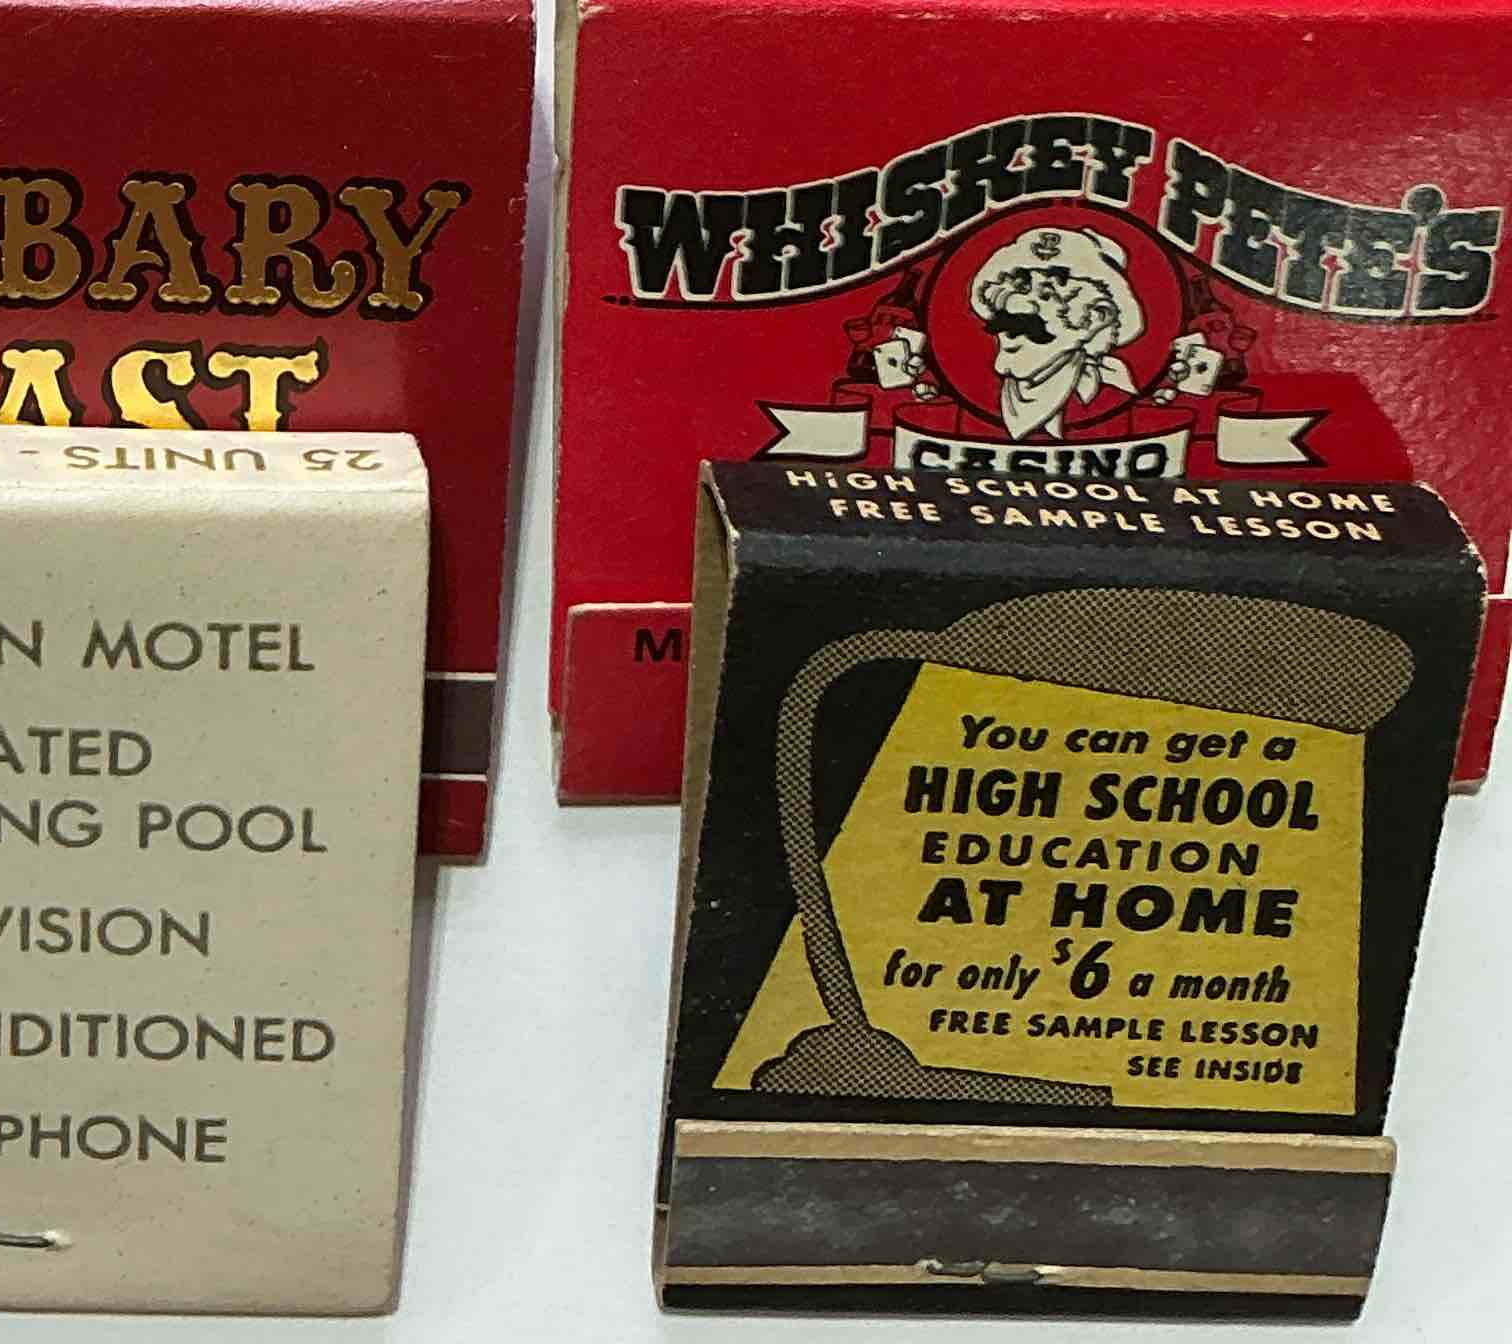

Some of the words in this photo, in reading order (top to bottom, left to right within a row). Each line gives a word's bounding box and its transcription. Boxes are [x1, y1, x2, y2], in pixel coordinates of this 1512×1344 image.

[613, 112, 1157, 304] WHISKEY
[1159, 135, 1506, 318] PETE'S
[65, 446, 267, 473] UNITS
[306, 449, 387, 471] 25
[829, 497, 943, 525] FREE
[971, 502, 1167, 536] SAMPLE
[1190, 511, 1386, 543] LESSON
[944, 476, 1150, 504] SCHOOL
[1171, 485, 1223, 508] AT
[1248, 487, 1397, 516] HOME
[81, 616, 315, 673] MOTEL
[959, 714, 1050, 754] You
[1062, 727, 1152, 758] can
[1164, 723, 1250, 764] get
[1265, 734, 1298, 761] a
[902, 764, 1062, 819] HIGH
[1085, 771, 1321, 832] SCHOOL
[136, 802, 329, 854] POOL
[920, 830, 1262, 876] EDUCATION
[916, 876, 1022, 927] AT
[1048, 881, 1301, 940] HOME
[882, 946, 947, 990] for
[955, 953, 1042, 998] only
[1050, 935, 1112, 1002] $6
[1126, 970, 1156, 1002] a
[1169, 965, 1291, 1005] month
[928, 1008, 1012, 1039] FREE
[1025, 1011, 1165, 1044] SAMPLE
[1180, 1017, 1320, 1050] LESSON
[1126, 1054, 1182, 1080] SEE
[1192, 1056, 1304, 1085] INSIDE
